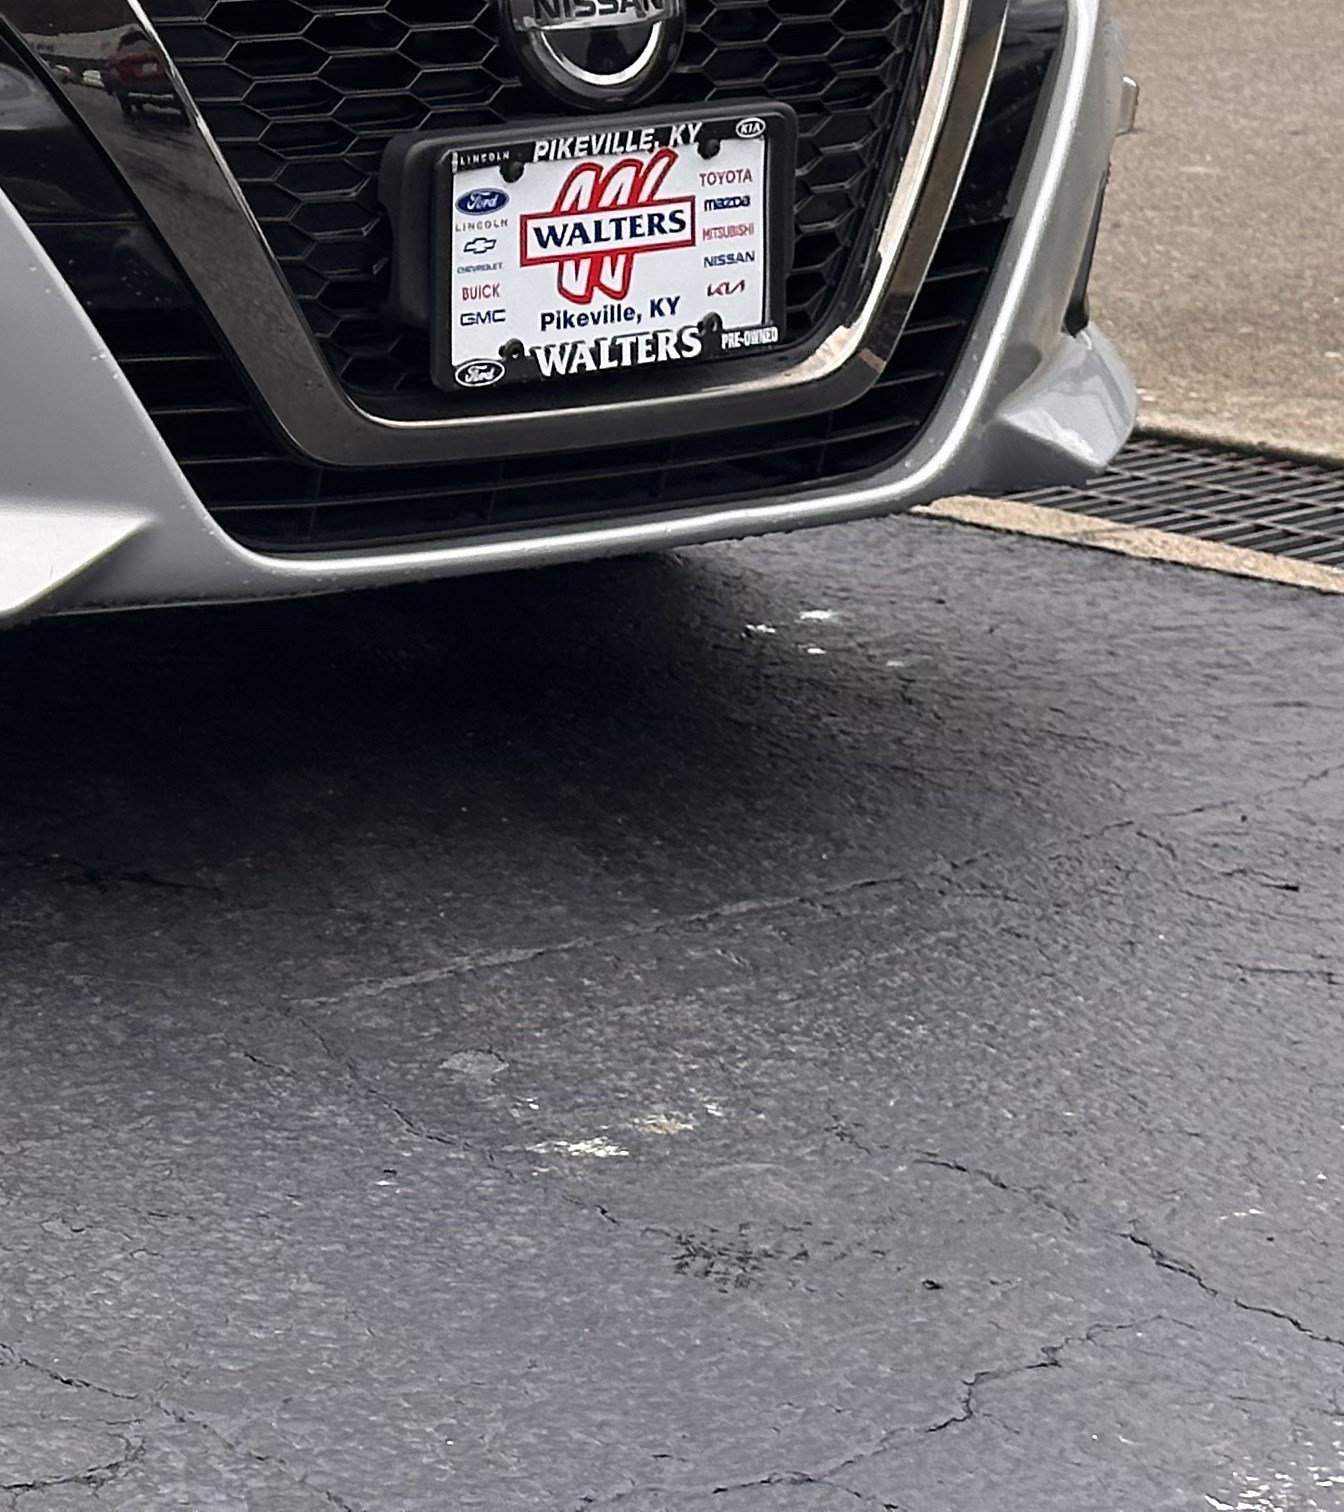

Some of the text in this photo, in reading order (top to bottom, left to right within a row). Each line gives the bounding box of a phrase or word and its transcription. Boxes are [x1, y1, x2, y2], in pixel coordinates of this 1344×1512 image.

[669, 122, 703, 148] KY
[739, 122, 761, 134] KIA
[460, 151, 510, 166] LINCOLN
[699, 168, 753, 187] TOYOTA
[466, 191, 499, 210] Ford
[455, 218, 508, 232] LINCOLN
[532, 208, 687, 249] WALTERS
[702, 222, 755, 241] MITSUBISHI
[456, 262, 503, 274] CHEVROLET
[703, 251, 755, 268] NISSAN
[462, 283, 500, 301] BUICK
[460, 309, 506, 326] GMC
[540, 296, 681, 332] Pikeville, KY
[721, 326, 779, 350] PRE-OWNED
[533, 326, 702, 377] WALTERS
[465, 365, 496, 383] Ford
